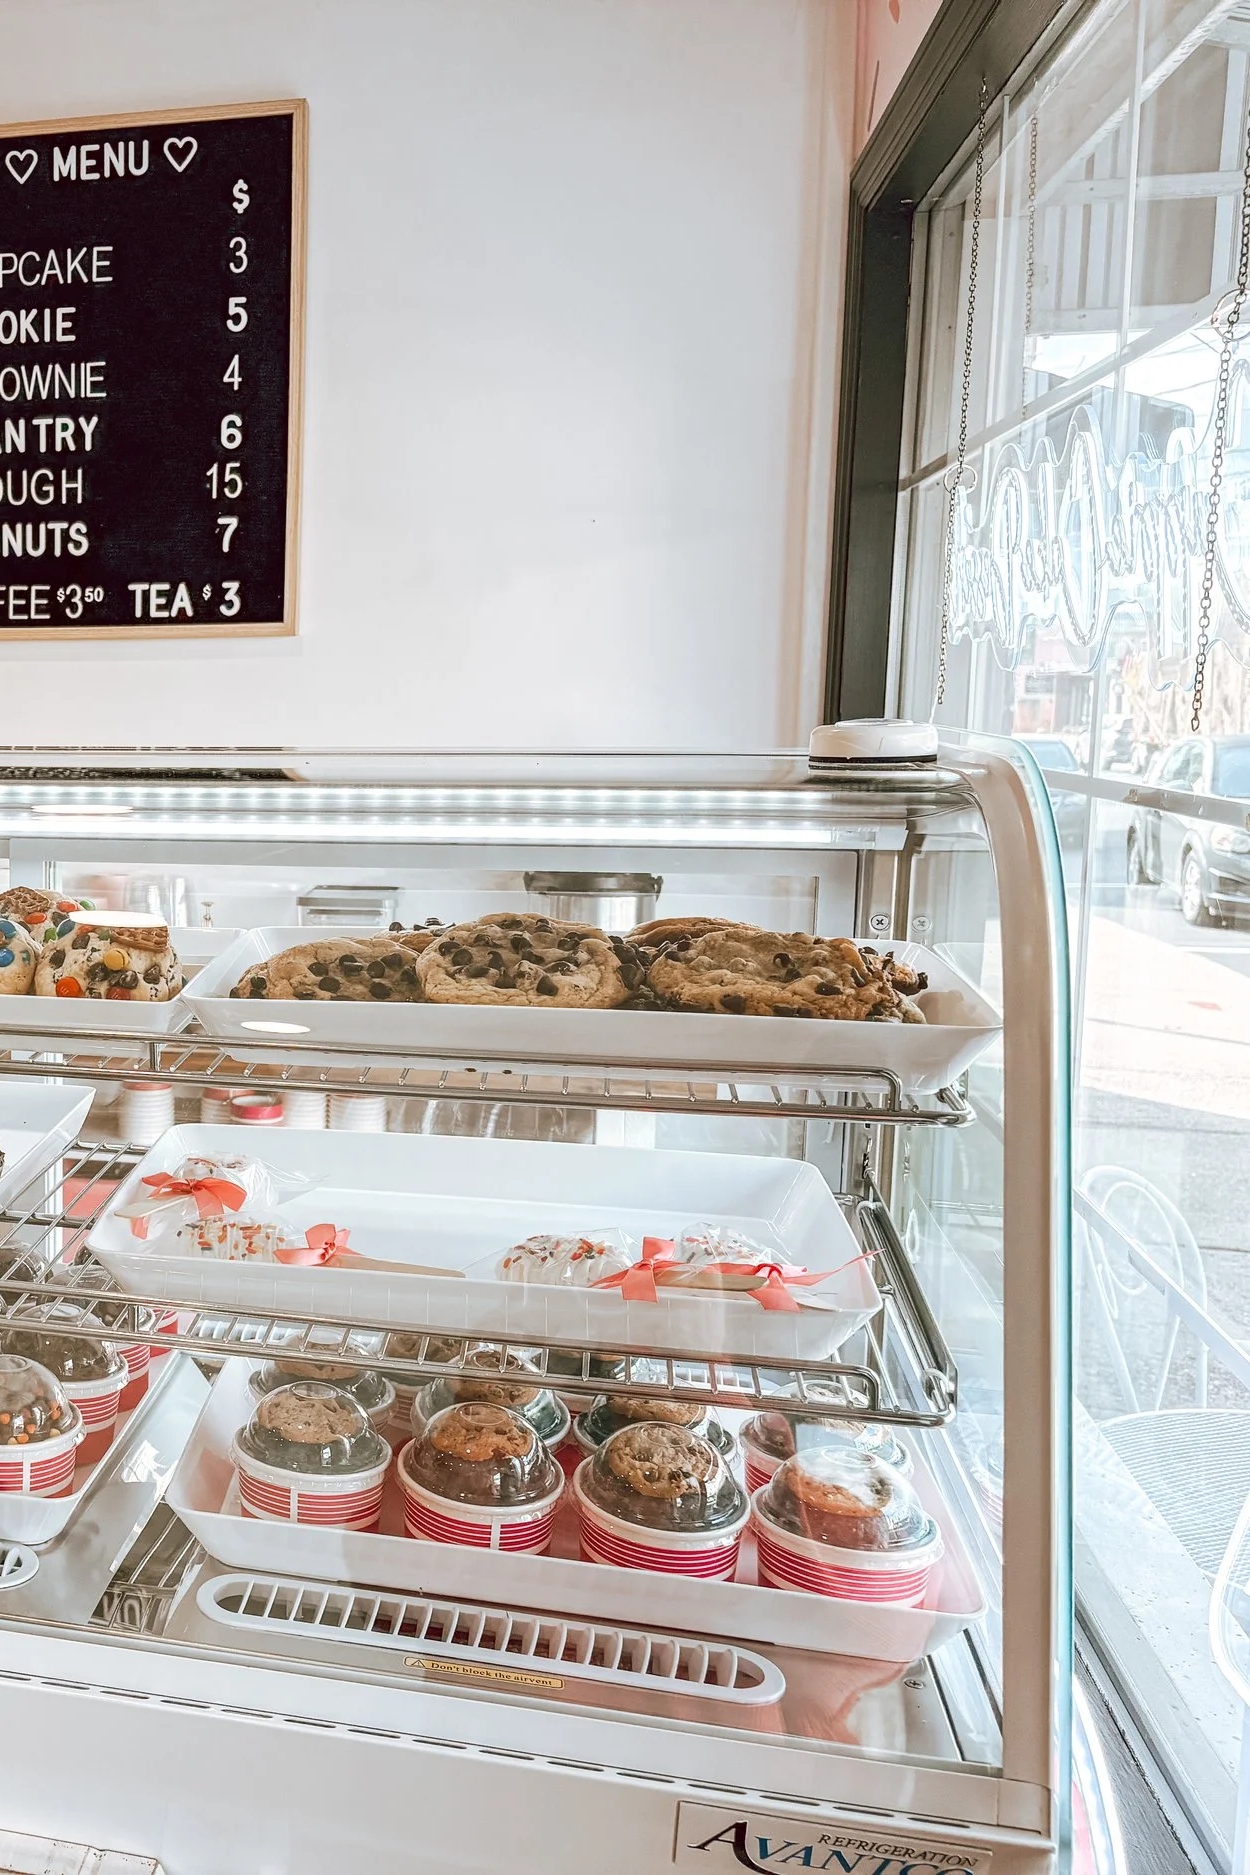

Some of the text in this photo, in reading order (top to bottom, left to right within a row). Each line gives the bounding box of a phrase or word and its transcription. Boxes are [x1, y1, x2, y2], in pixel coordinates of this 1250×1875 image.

[52, 139, 150, 182] MENU
[232, 178, 250, 214] $
[229, 236, 248, 274] 3
[226, 296, 248, 333] 5
[222, 354, 243, 391] 4
[220, 414, 243, 450] 6
[206, 462, 243, 500] 15
[216, 516, 239, 553] 7
[127, 582, 194, 618] TEA
[431, 1662, 459, 1672] Don't
[462, 1667, 491, 1677] block
[494, 1671, 511, 1680] the
[818, 1833, 979, 1868] REFRIGERATION
